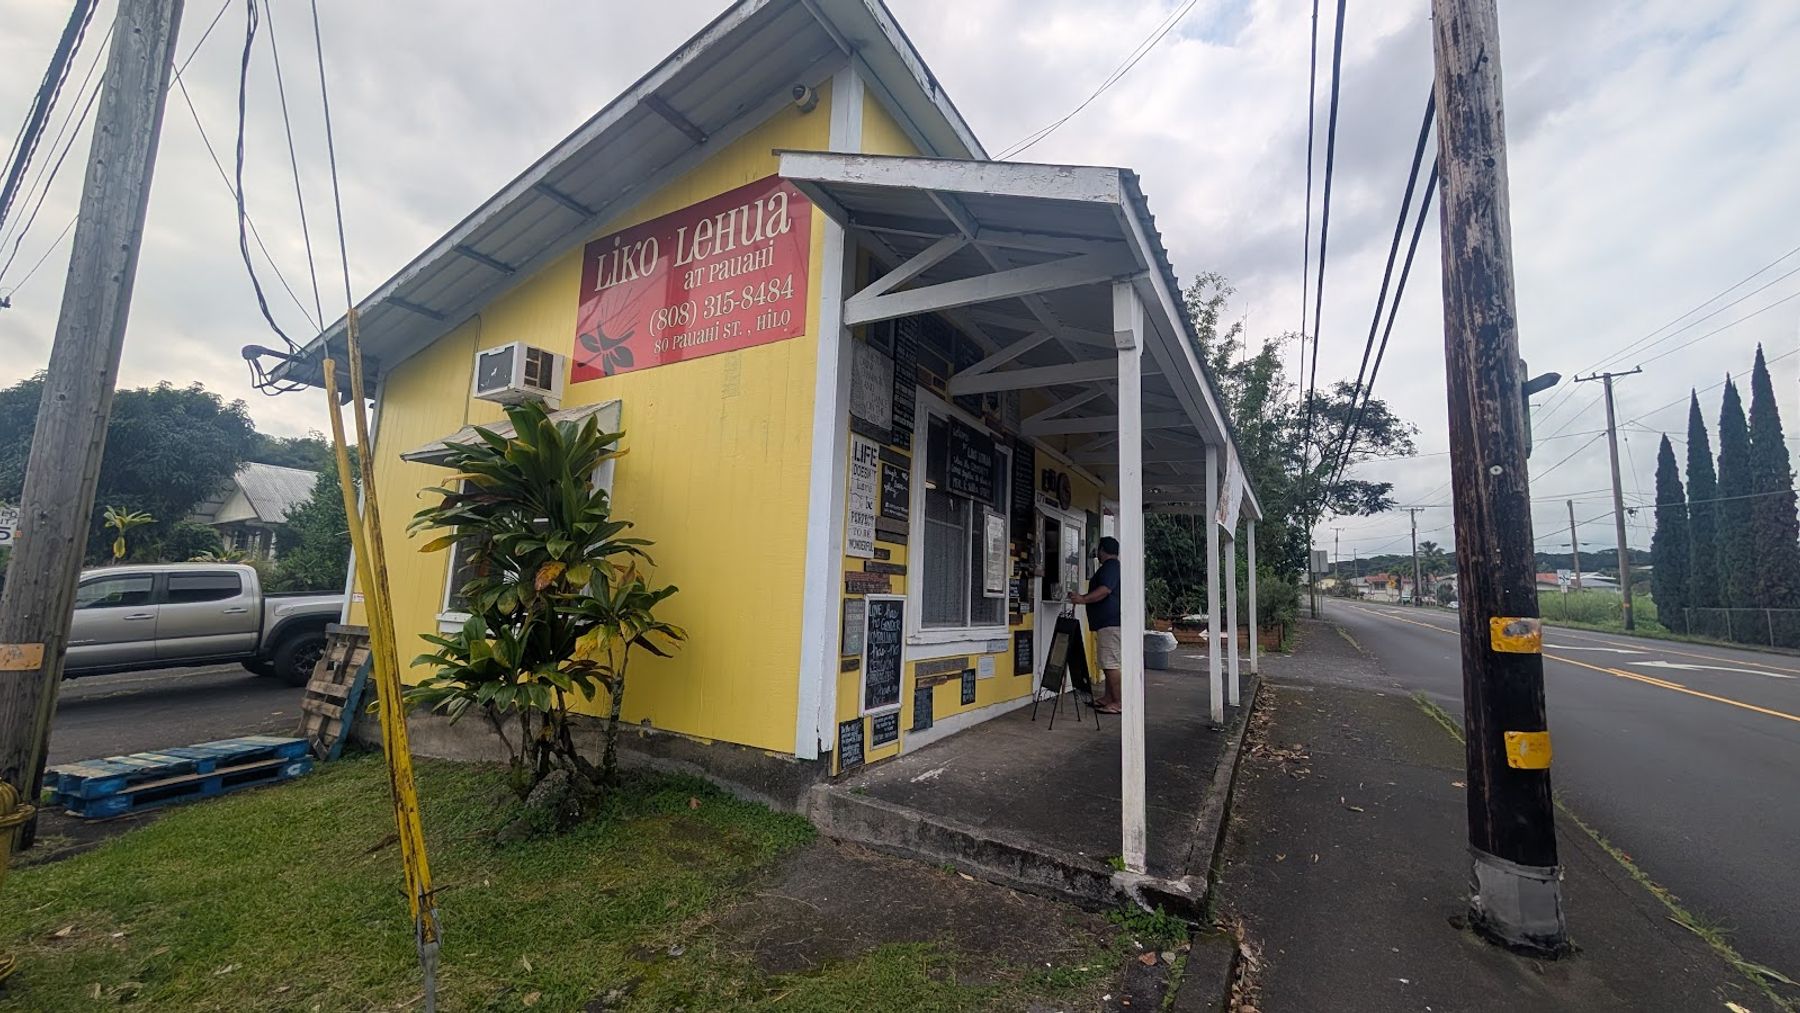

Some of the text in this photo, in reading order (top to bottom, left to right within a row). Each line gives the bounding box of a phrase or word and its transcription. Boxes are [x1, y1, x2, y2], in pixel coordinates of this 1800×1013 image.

[649, 274, 794, 337] (808) 315-8484
[654, 335, 669, 354] 80
[854, 441, 877, 467] LIFE
